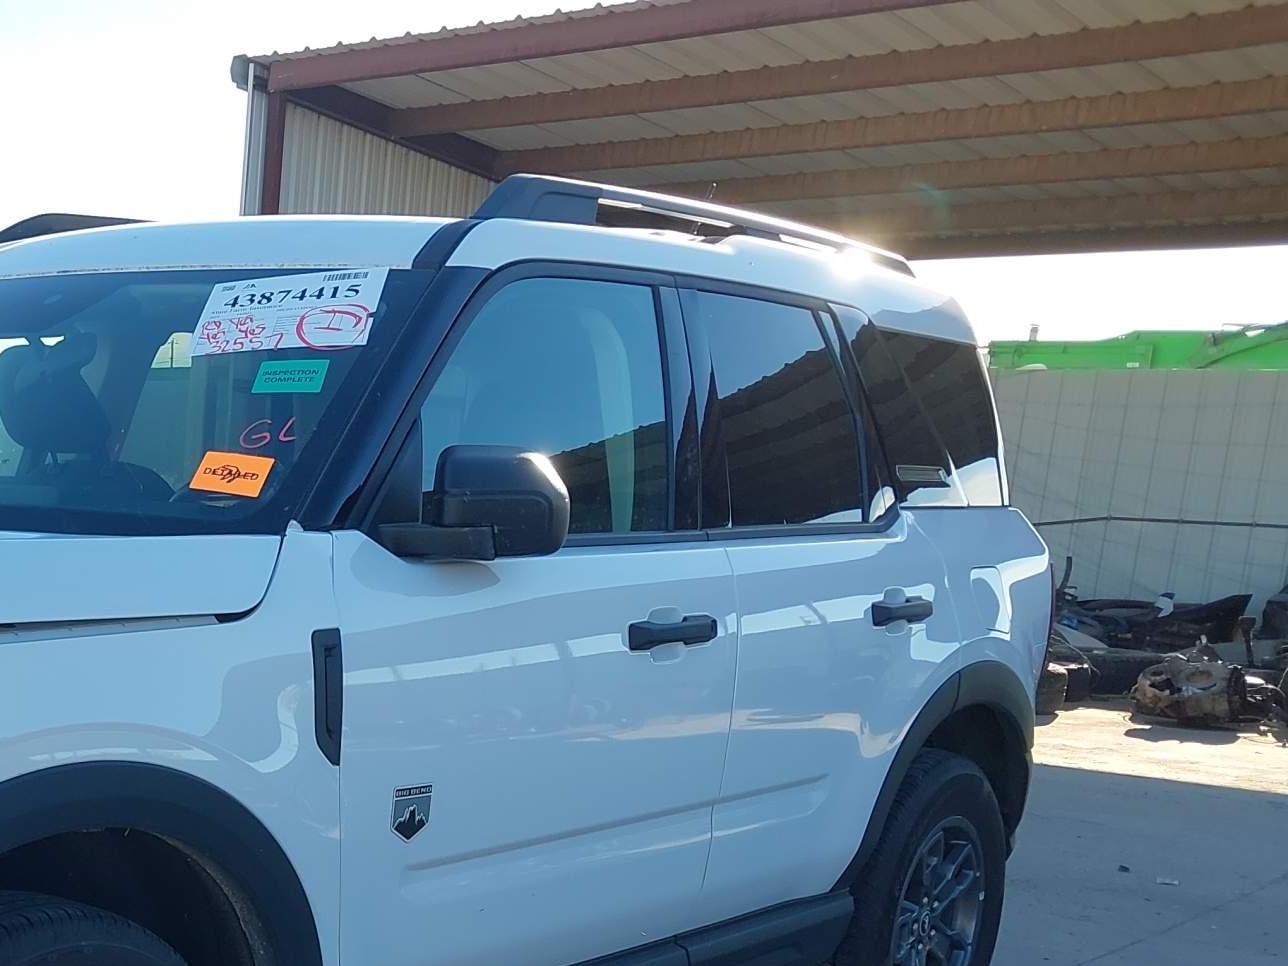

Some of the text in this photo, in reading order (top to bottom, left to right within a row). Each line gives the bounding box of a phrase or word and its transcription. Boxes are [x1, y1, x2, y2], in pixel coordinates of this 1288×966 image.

[223, 284, 362, 309] 43874415
[262, 369, 319, 377] INSPECTION
[264, 376, 314, 384] COMPLETE
